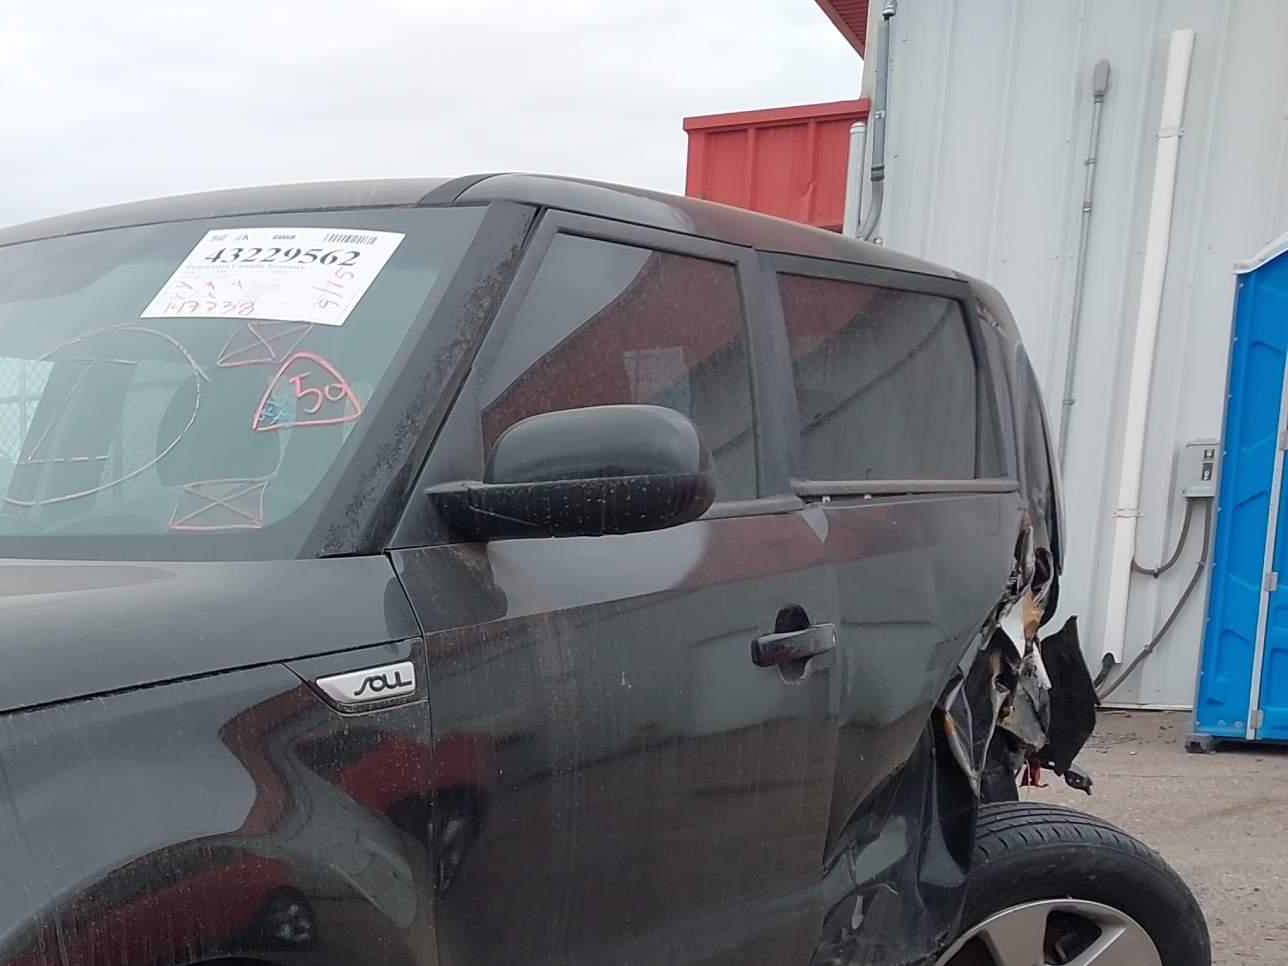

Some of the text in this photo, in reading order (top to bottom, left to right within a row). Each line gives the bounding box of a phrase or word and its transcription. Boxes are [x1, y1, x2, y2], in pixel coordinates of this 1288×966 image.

[205, 247, 361, 266] 43229562
[289, 371, 348, 414] 50
[353, 671, 413, 697] SOUL
